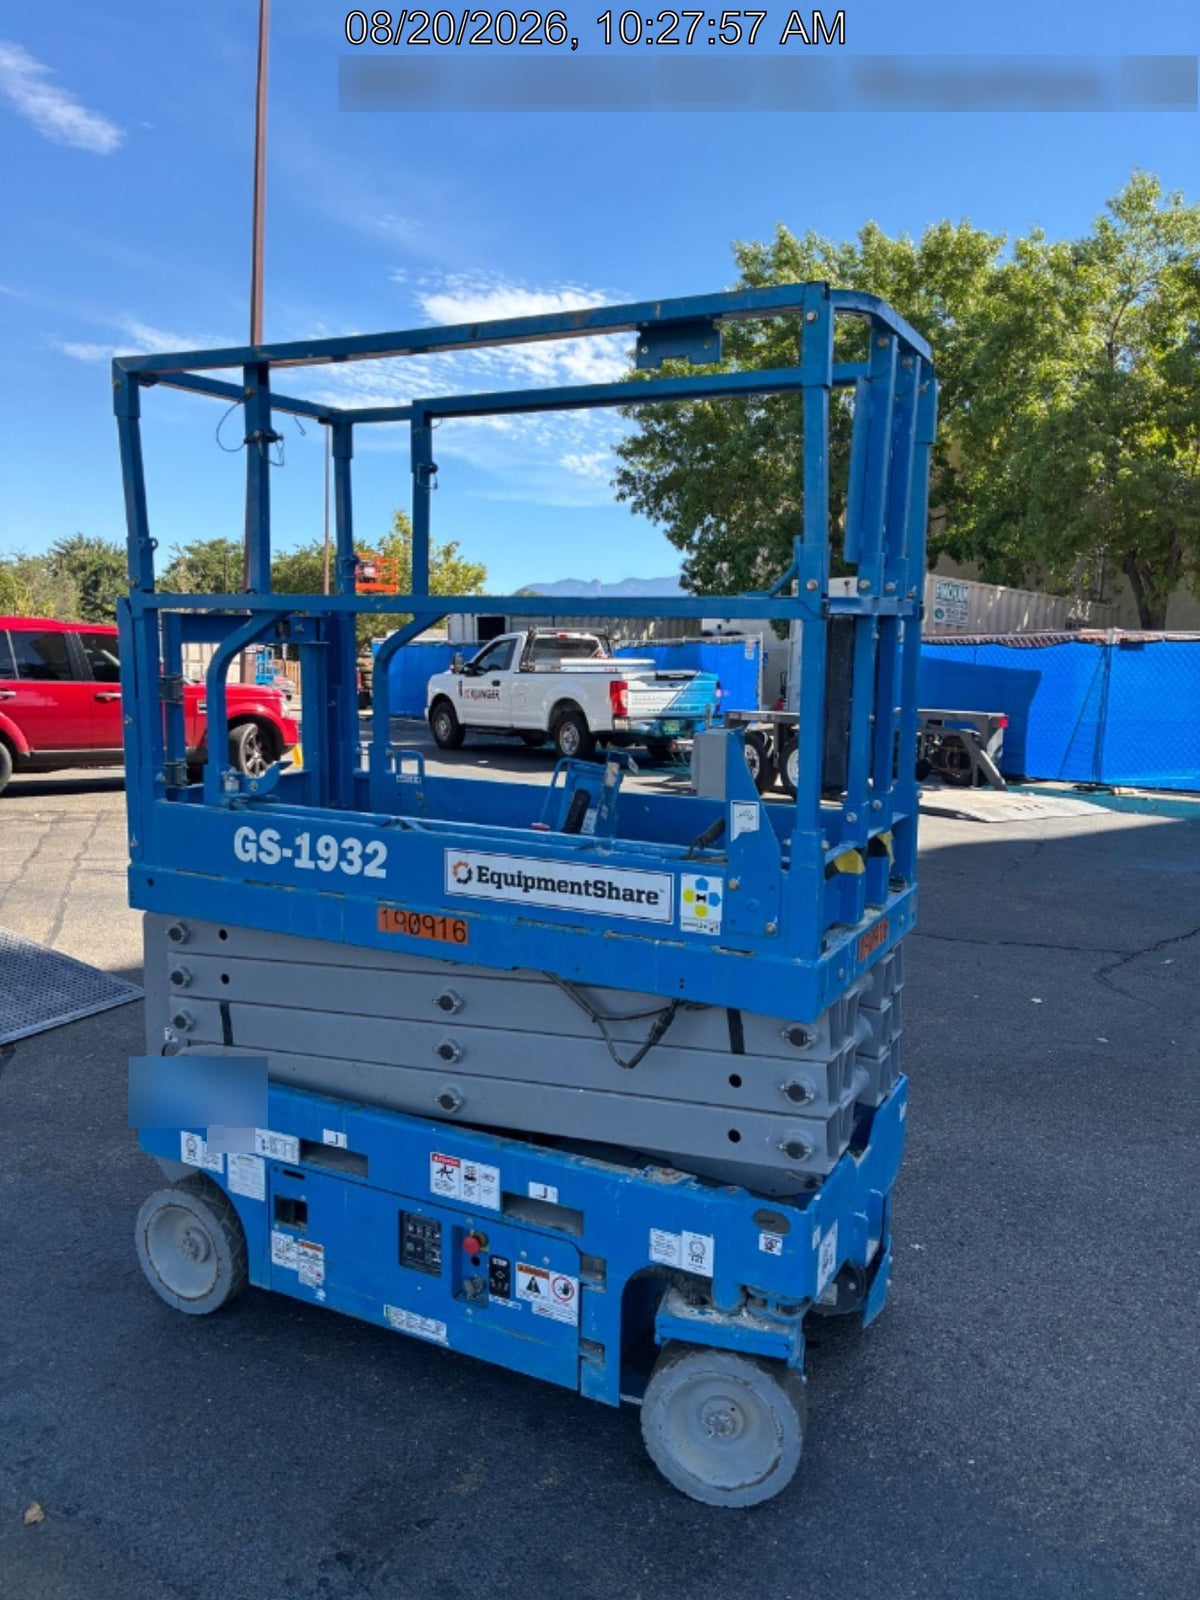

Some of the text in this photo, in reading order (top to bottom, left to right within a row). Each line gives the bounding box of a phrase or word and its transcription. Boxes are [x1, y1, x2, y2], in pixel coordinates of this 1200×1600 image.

[234, 826, 388, 879] GS-1932
[477, 866, 659, 905] EquipmentShare
[382, 907, 466, 942] 190916
